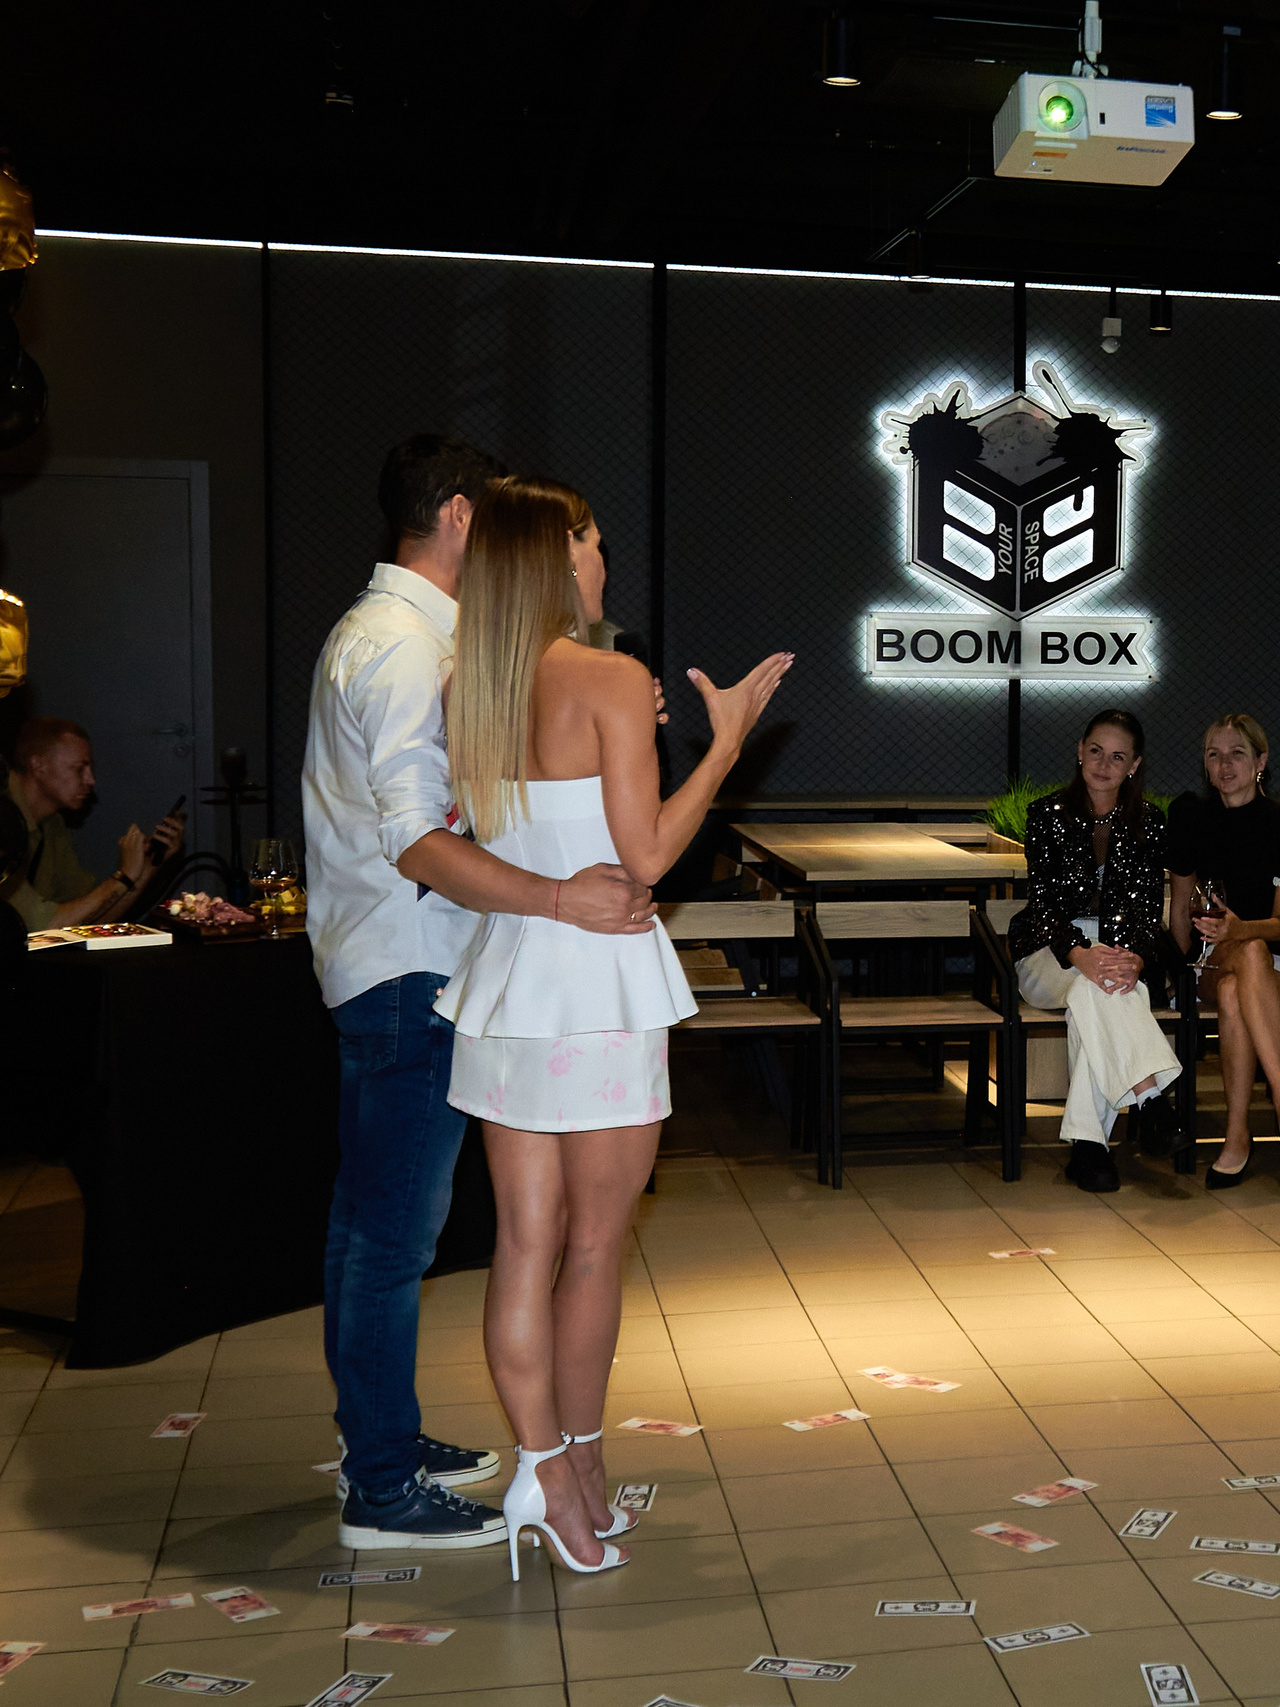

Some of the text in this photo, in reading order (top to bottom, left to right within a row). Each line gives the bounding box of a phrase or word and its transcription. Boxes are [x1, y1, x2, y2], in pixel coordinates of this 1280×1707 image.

[998, 523, 1013, 575] YOUR
[1024, 521, 1040, 584] SPACE
[876, 629, 1138, 666] BOOM BOX
